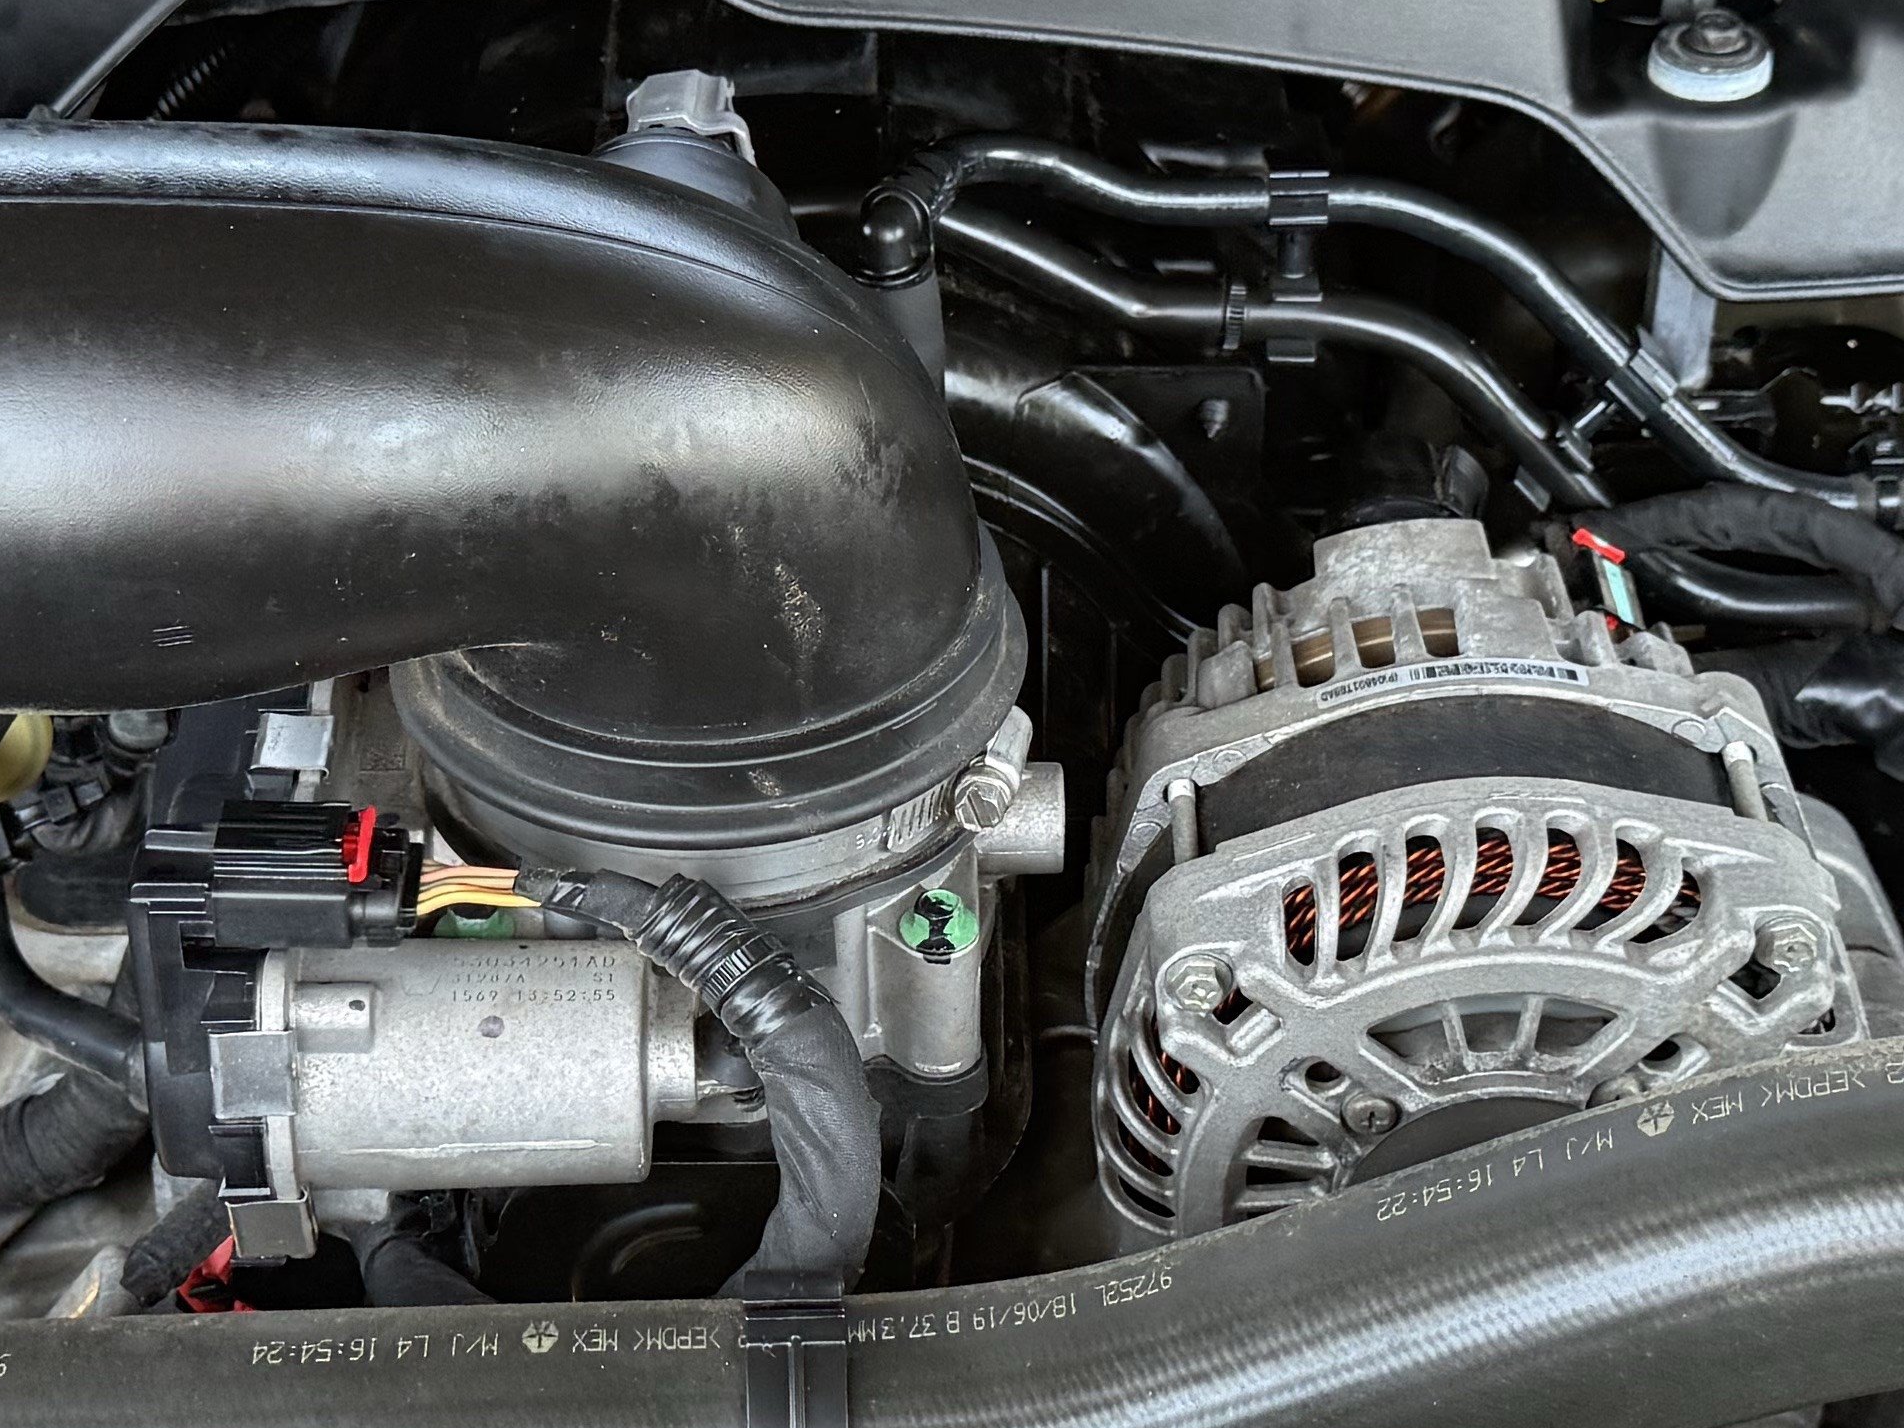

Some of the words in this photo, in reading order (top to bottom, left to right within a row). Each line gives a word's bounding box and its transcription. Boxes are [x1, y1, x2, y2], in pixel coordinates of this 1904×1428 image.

[1691, 1091, 1744, 1124] MEX
[1513, 1148, 1545, 1178] L4
[1376, 1162, 1494, 1222] 16:54:22
[1094, 1266, 1174, 1307] 97252L
[945, 1310, 961, 1334] B
[972, 1291, 1078, 1331] 18/06/19
[572, 1326, 619, 1353] MEX
[847, 1313, 938, 1343] 37.3MM
[251, 1337, 378, 1366] 16:54:24
[396, 1333, 431, 1360] L4
